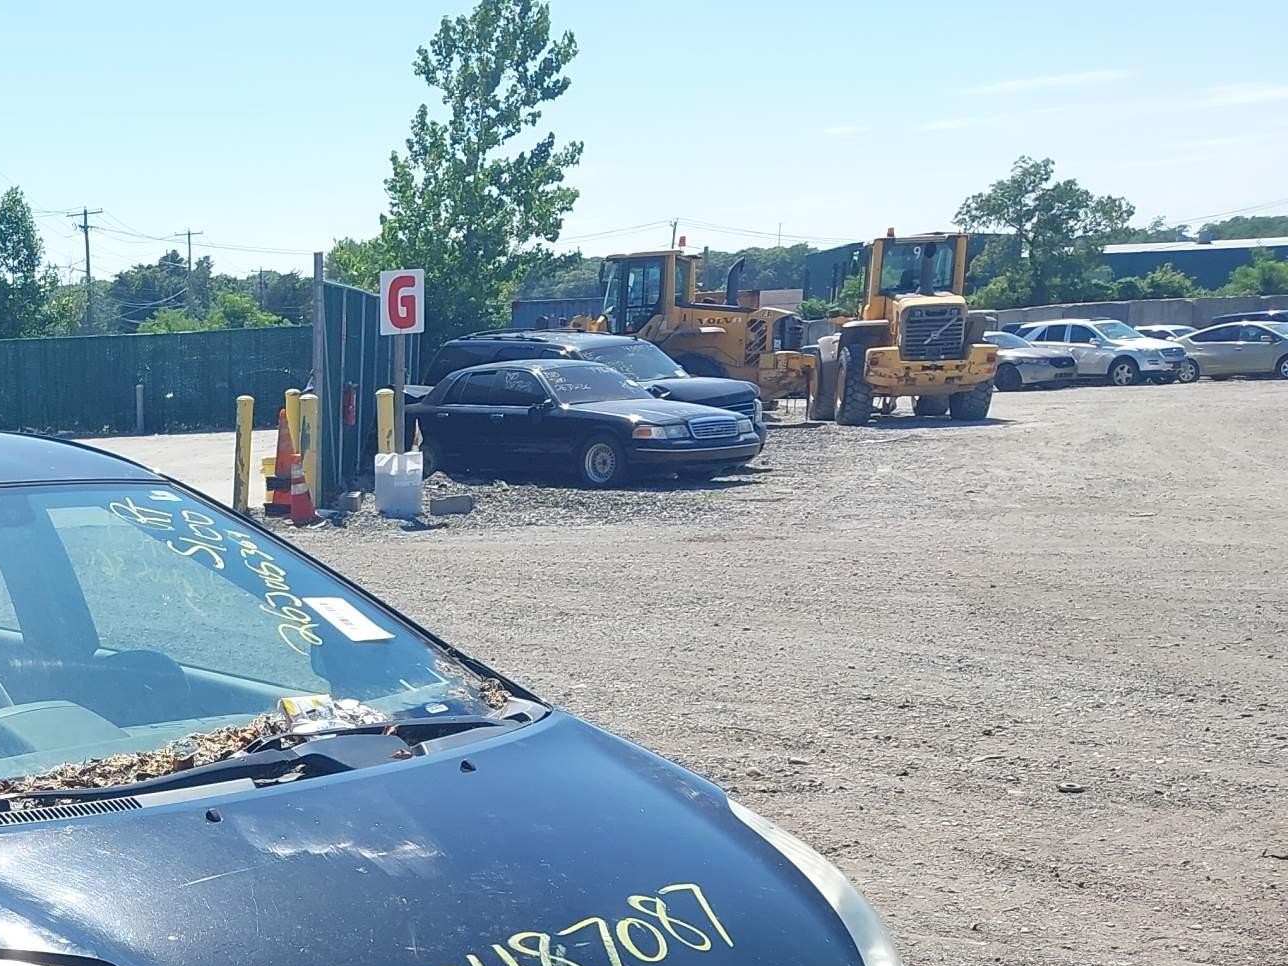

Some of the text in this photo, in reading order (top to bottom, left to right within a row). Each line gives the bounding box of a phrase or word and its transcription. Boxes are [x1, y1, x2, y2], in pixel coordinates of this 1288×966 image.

[913, 246, 921, 260] 9
[388, 274, 416, 329] G
[697, 316, 742, 325] VOLVO
